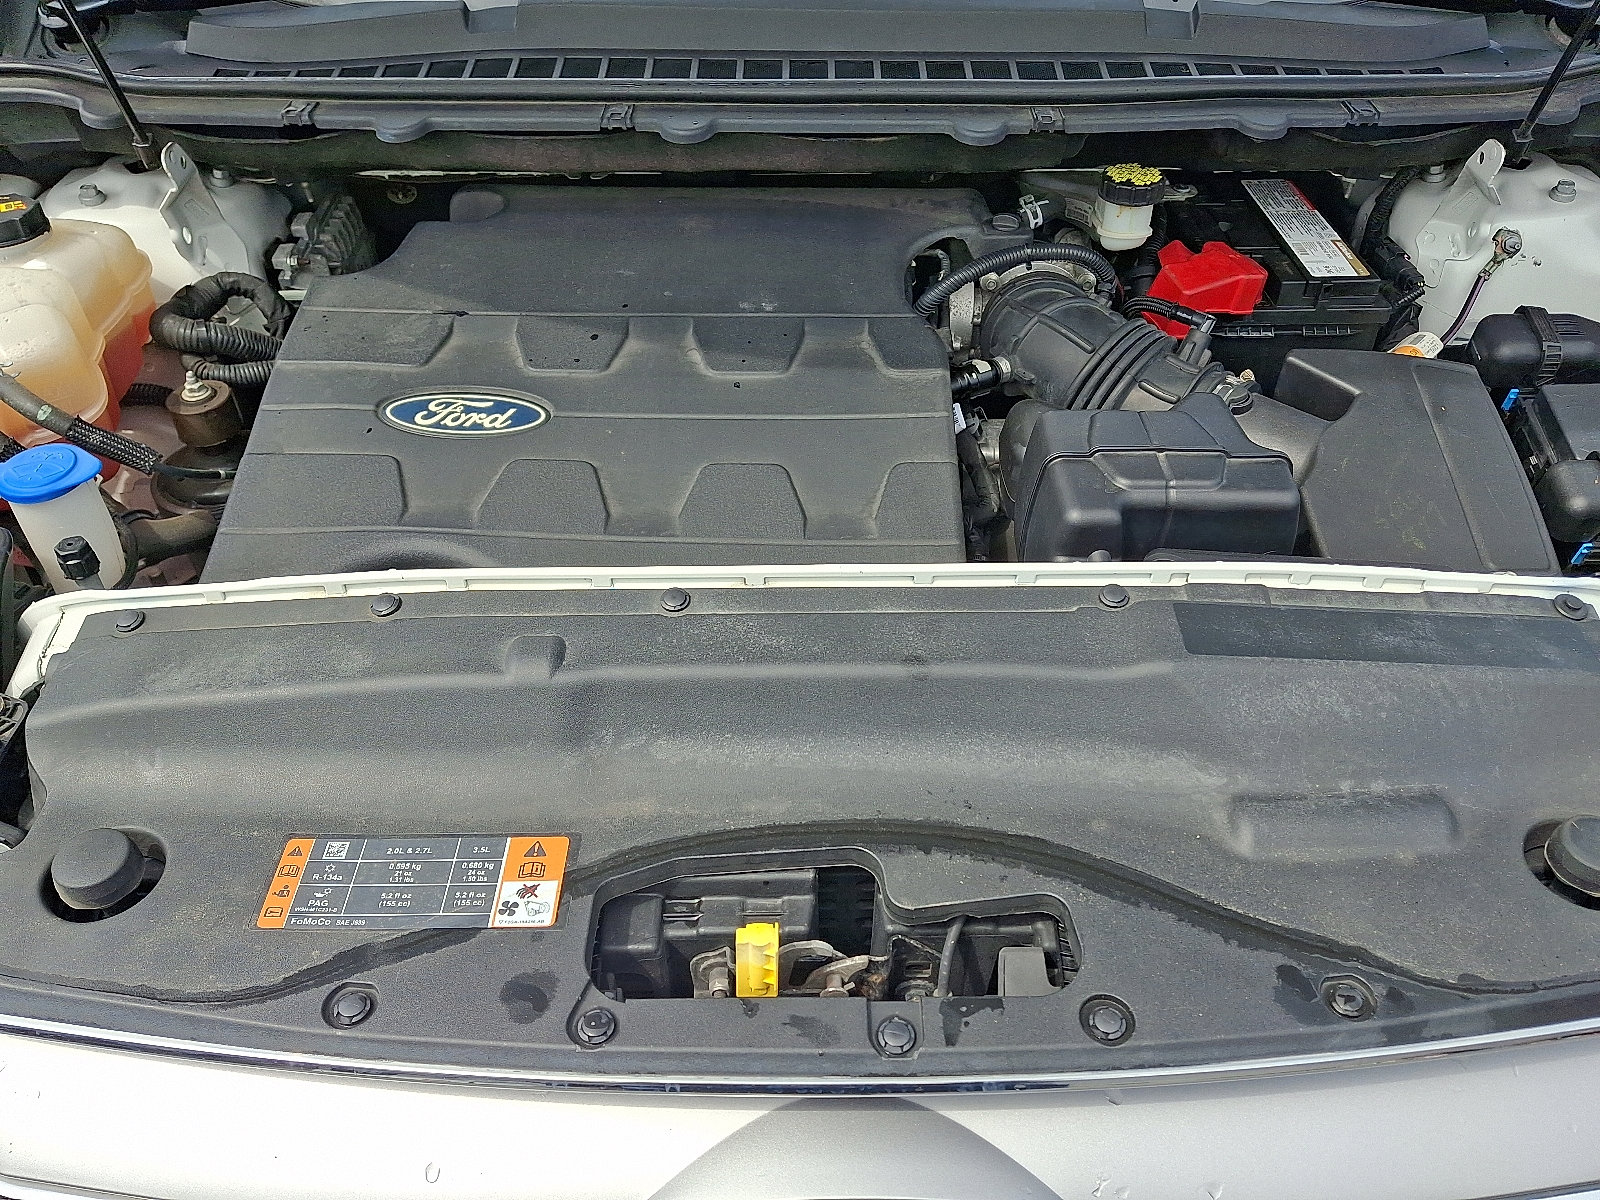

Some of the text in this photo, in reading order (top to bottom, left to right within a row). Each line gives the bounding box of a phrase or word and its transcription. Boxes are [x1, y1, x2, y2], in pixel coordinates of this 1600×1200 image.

[413, 398, 518, 429] Ford
[386, 847, 405, 855] 2.0L
[472, 846, 491, 854] 3.5L
[411, 862, 422, 871] kg
[461, 861, 495, 871] 0.680 kg
[312, 873, 343, 881] R-134a
[454, 891, 468, 899] 5.2
[468, 891, 475, 899] fl
[307, 899, 330, 907] PAG
[378, 900, 411, 909] (155 cc)
[453, 899, 486, 908] (155 cc)
[290, 917, 331, 926] FoMoCo
